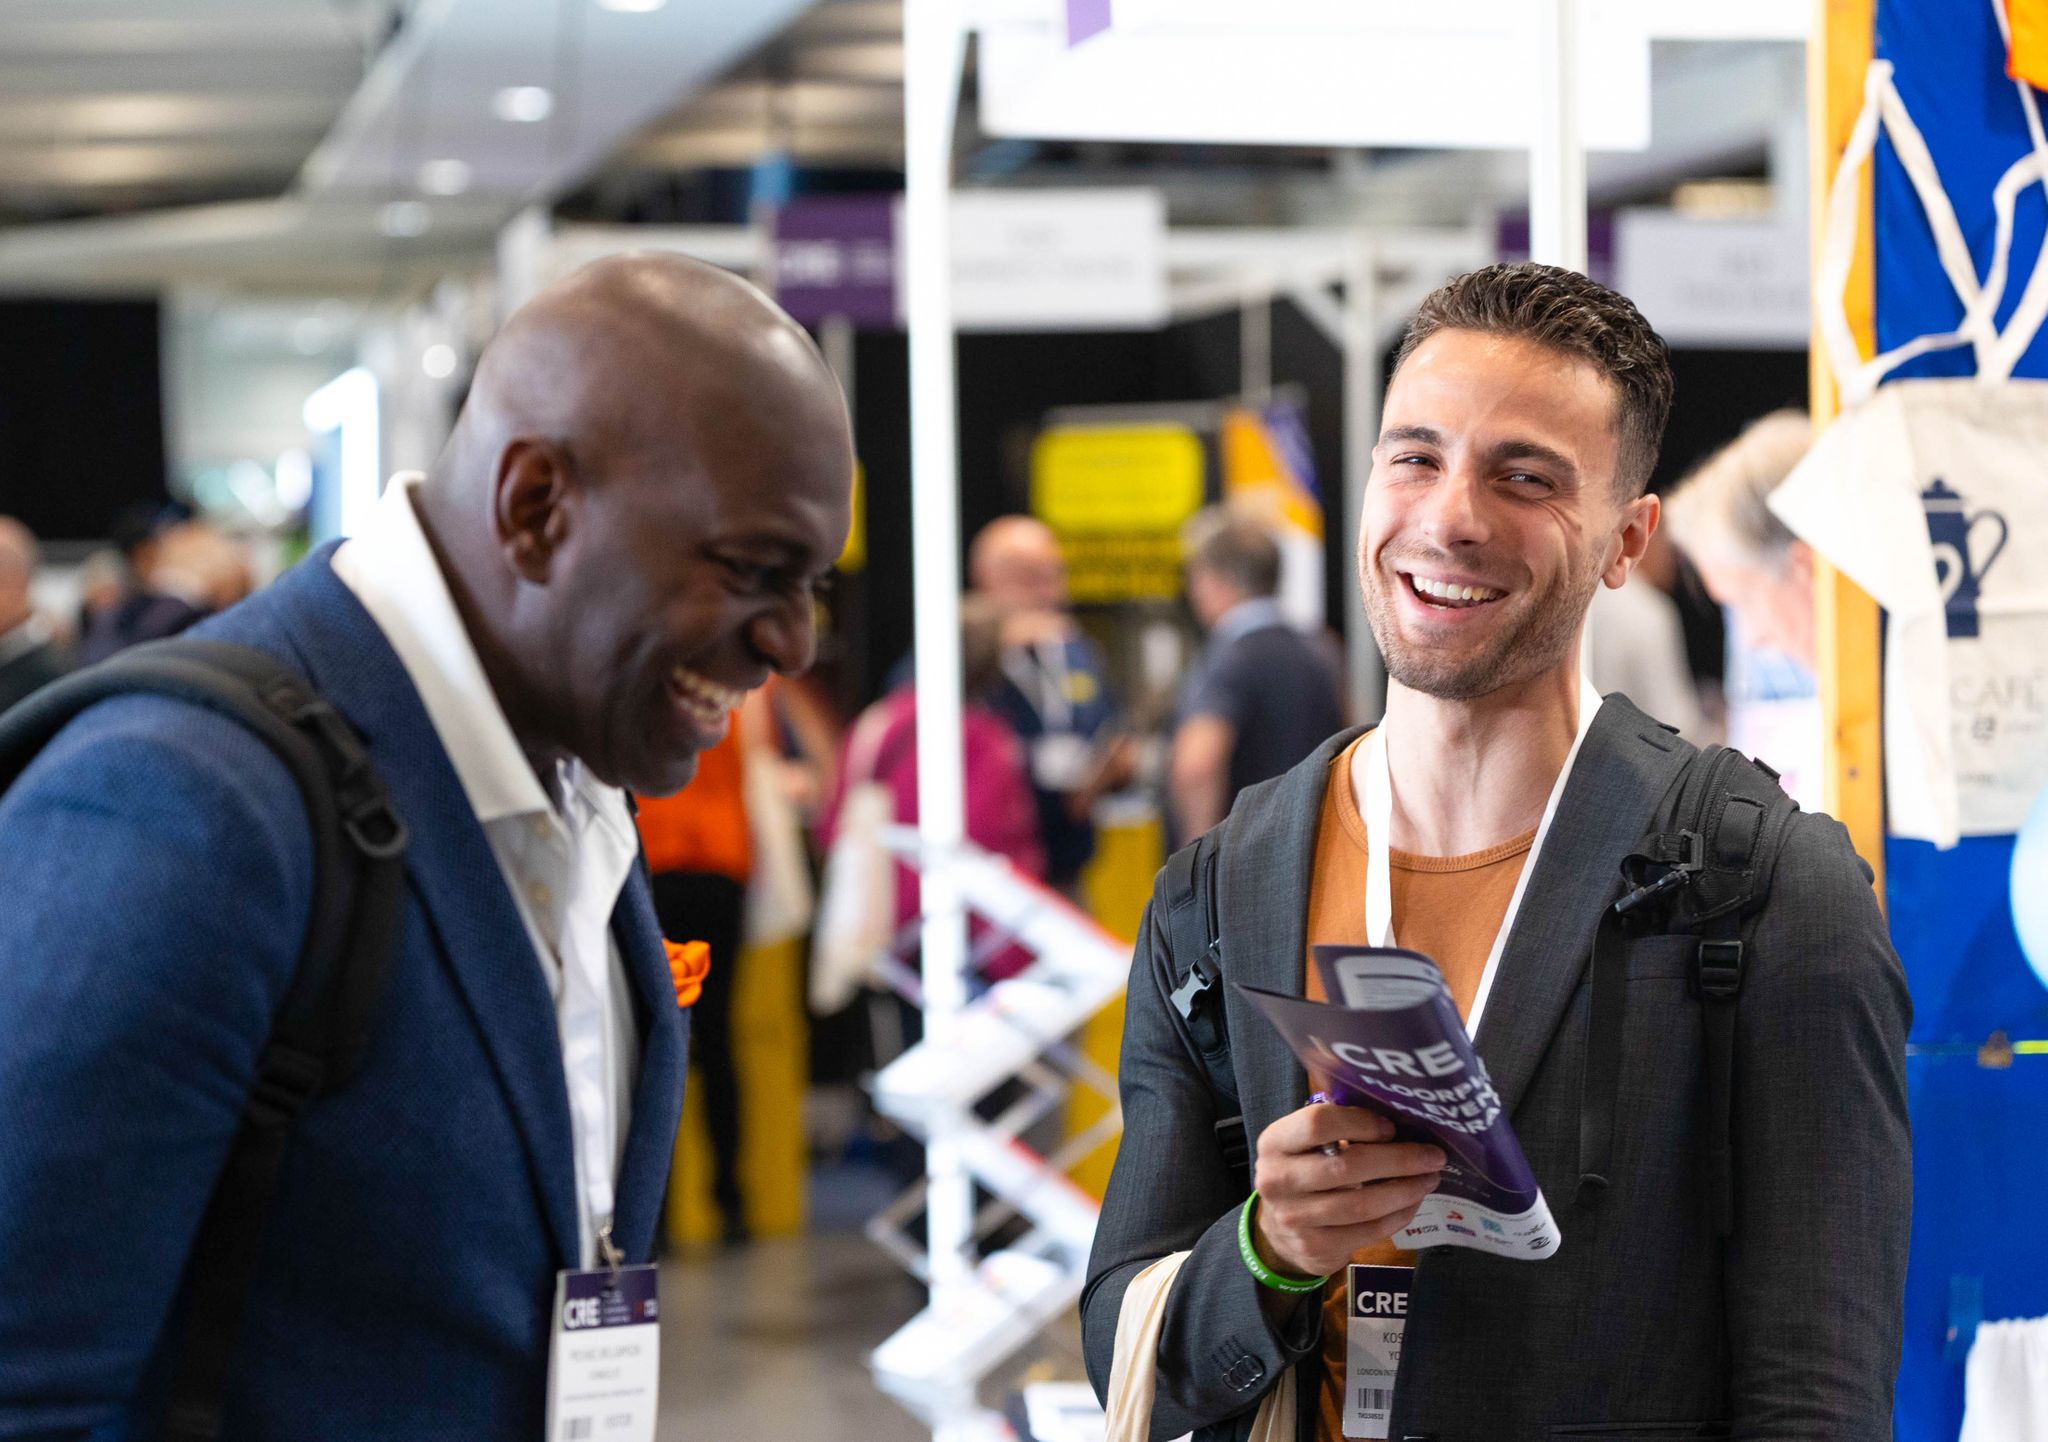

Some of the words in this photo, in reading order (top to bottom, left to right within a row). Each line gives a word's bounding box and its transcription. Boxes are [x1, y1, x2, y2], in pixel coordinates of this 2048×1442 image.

[1331, 1041, 1465, 1078] CRE
[563, 1297, 602, 1329] CRE
[1357, 1291, 1408, 1315] CRE
